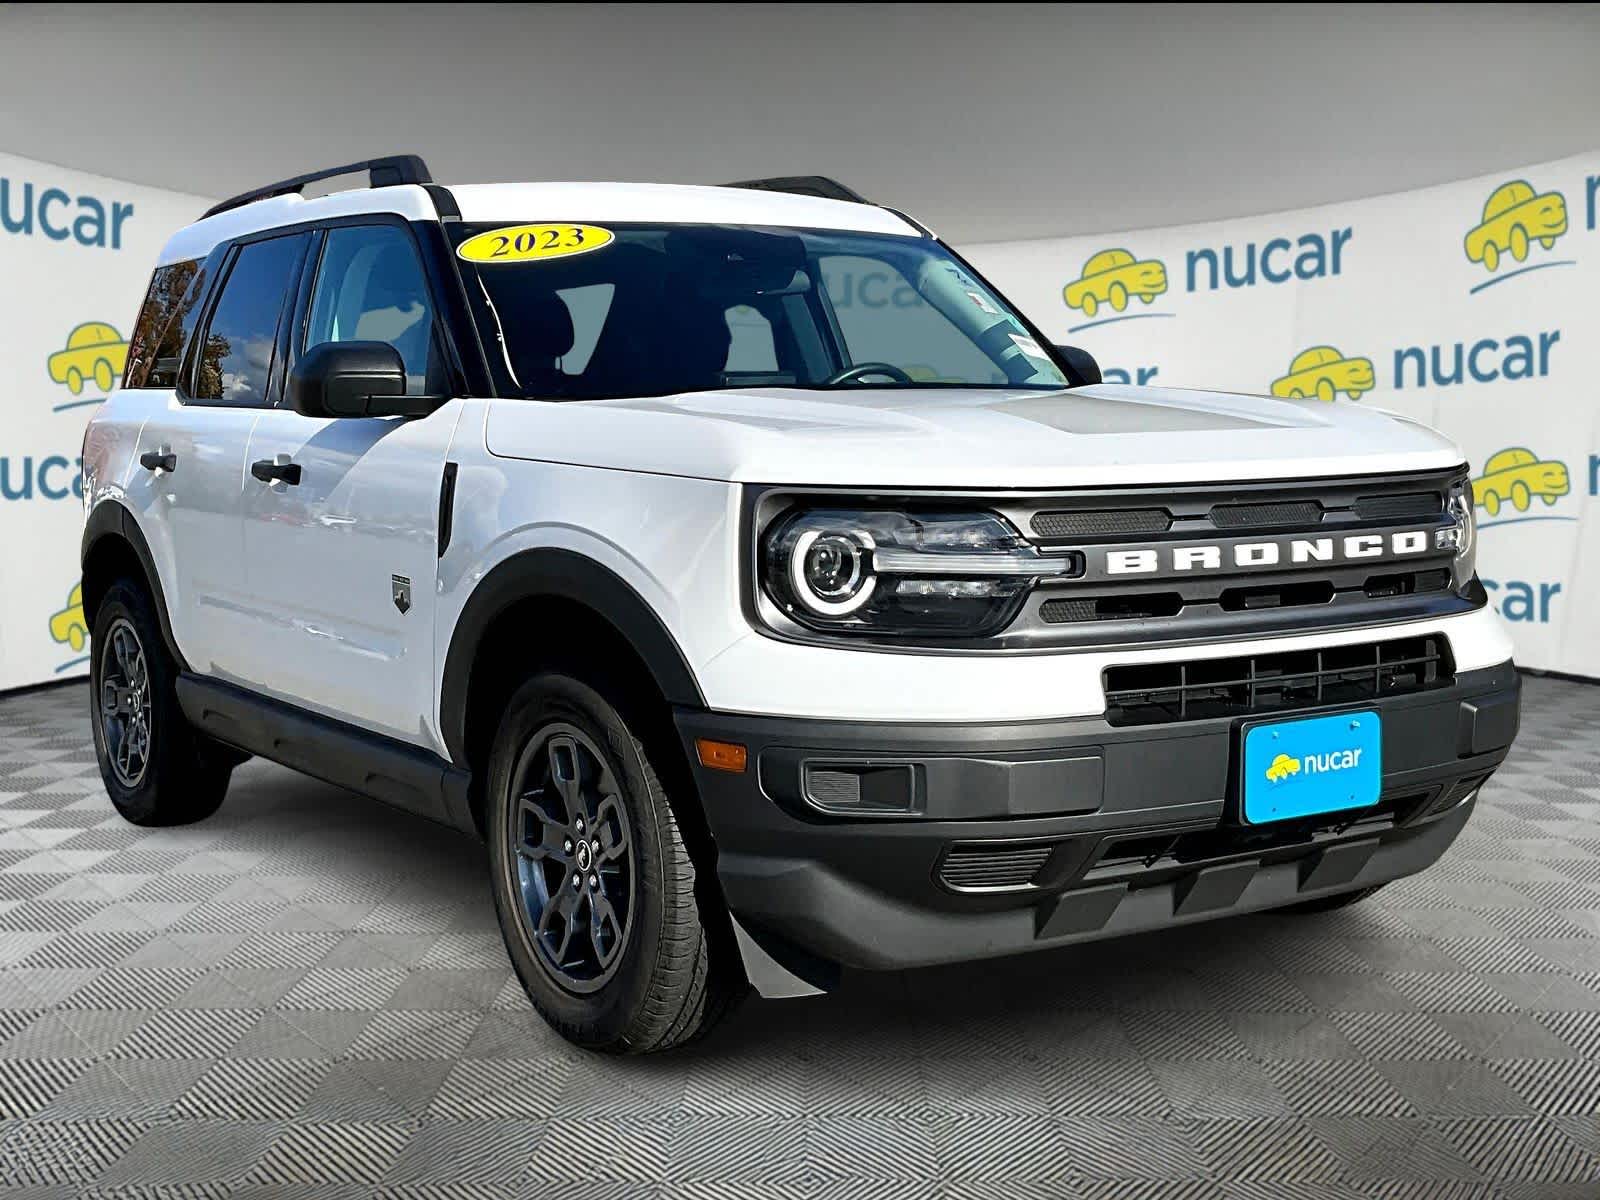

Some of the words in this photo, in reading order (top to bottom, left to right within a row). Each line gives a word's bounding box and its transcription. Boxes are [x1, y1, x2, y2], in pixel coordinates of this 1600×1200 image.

[488, 228, 585, 258] 2023
[1186, 227, 1353, 292] nucar
[1393, 330, 1561, 389] nucar
[1106, 531, 1428, 574] BRONCO
[1304, 748, 1363, 774] nucar
